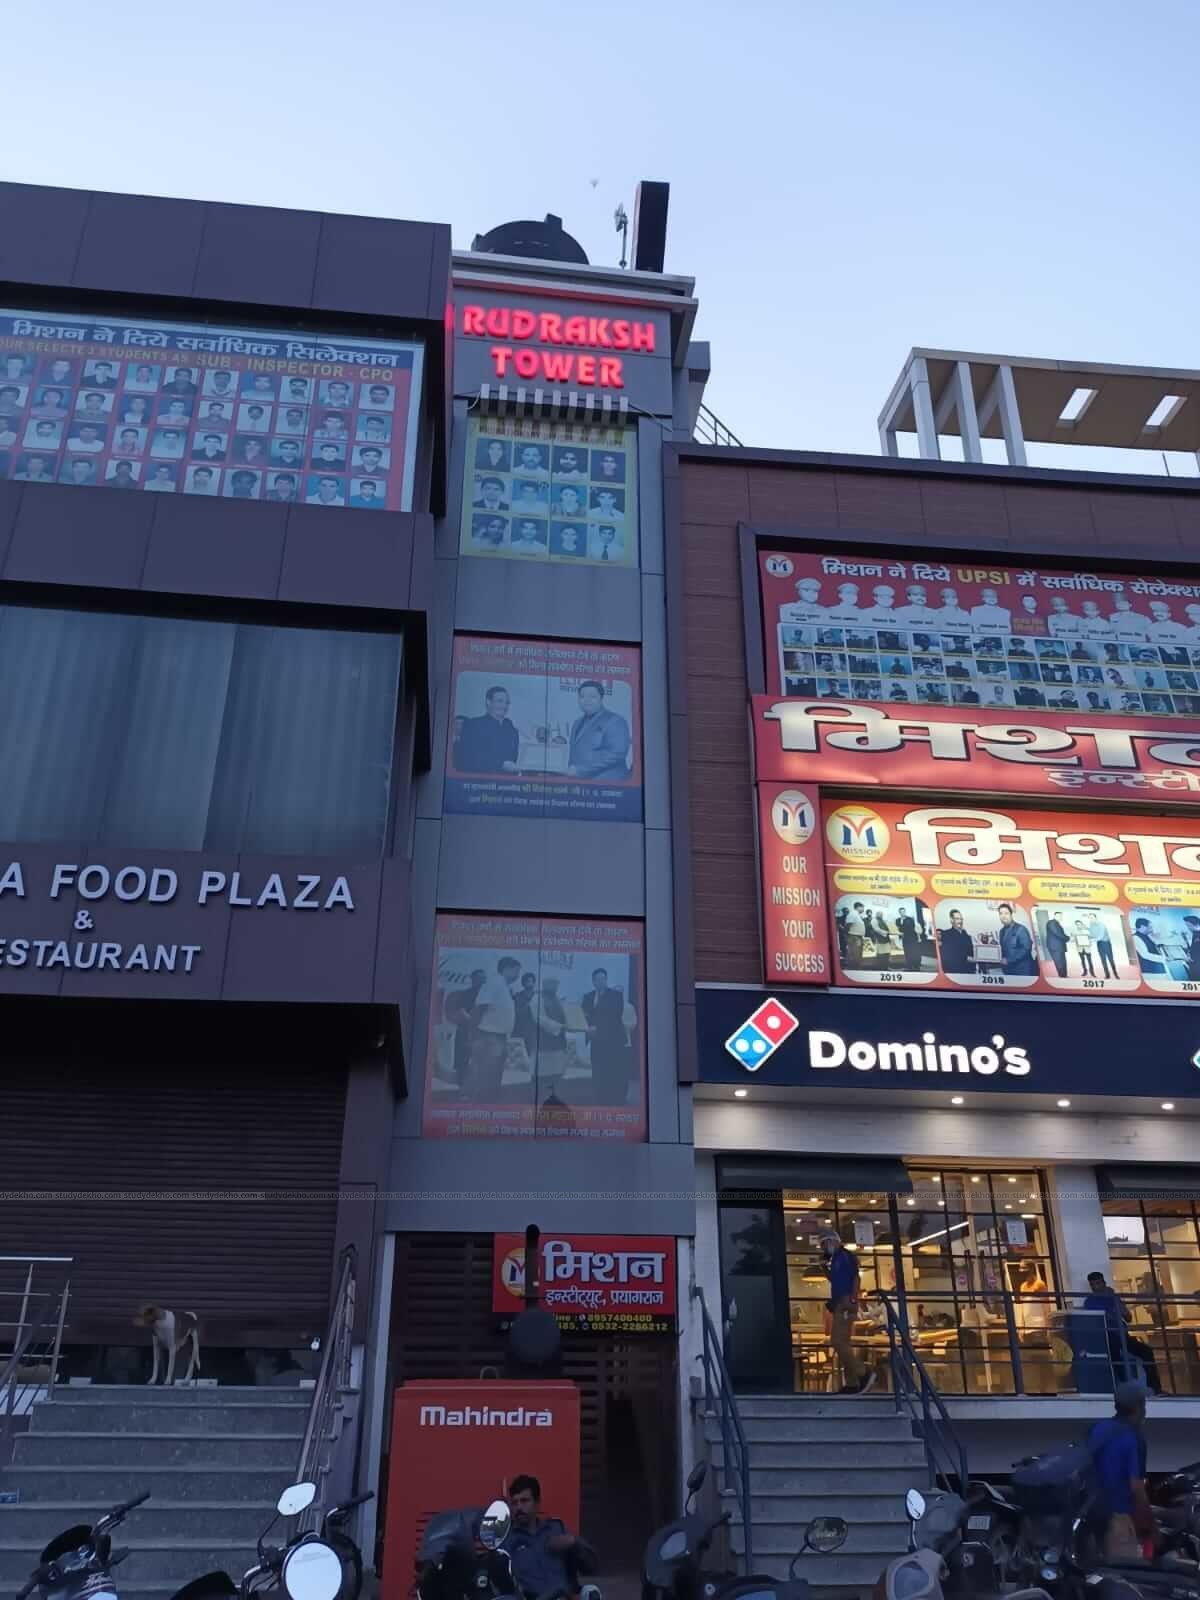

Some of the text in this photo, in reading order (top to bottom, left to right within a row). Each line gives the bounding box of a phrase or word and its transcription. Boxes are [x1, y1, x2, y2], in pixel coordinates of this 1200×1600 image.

[12, 319, 87, 341] मिशन
[93, 327, 116, 344] ने
[176, 336, 280, 357] सर्वाधिक
[463, 305, 656, 352] RUDRAKSH
[196, 354, 232, 369] SUB
[247, 358, 344, 377] INSPECTOR
[359, 367, 393, 382] CPO
[491, 346, 625, 389] TOWER
[820, 556, 884, 579] मिशन
[887, 562, 906, 580] ने
[911, 563, 951, 582] दिये
[957, 568, 1010, 585] UPSI
[1016, 570, 1037, 587] में
[1040, 572, 1125, 593] सर्वाधिक
[841, 847, 880, 856] MISSION
[782, 856, 808, 874] OUR
[0, 862, 356, 910] A FOOD PLAZA
[772, 886, 821, 907] MISSION
[74, 910, 94, 930] &
[781, 919, 815, 939] YOUR
[775, 952, 825, 973] SUCCESS
[880, 973, 903, 982] 2019
[981, 975, 1005, 985] 2018
[1082, 979, 1105, 989] 2017
[808, 1030, 1031, 1077] Domino's
[542, 1240, 667, 1283] मिशन
[610, 1289, 664, 1305] प्रयागराज
[420, 1406, 553, 1426] Mahindra
